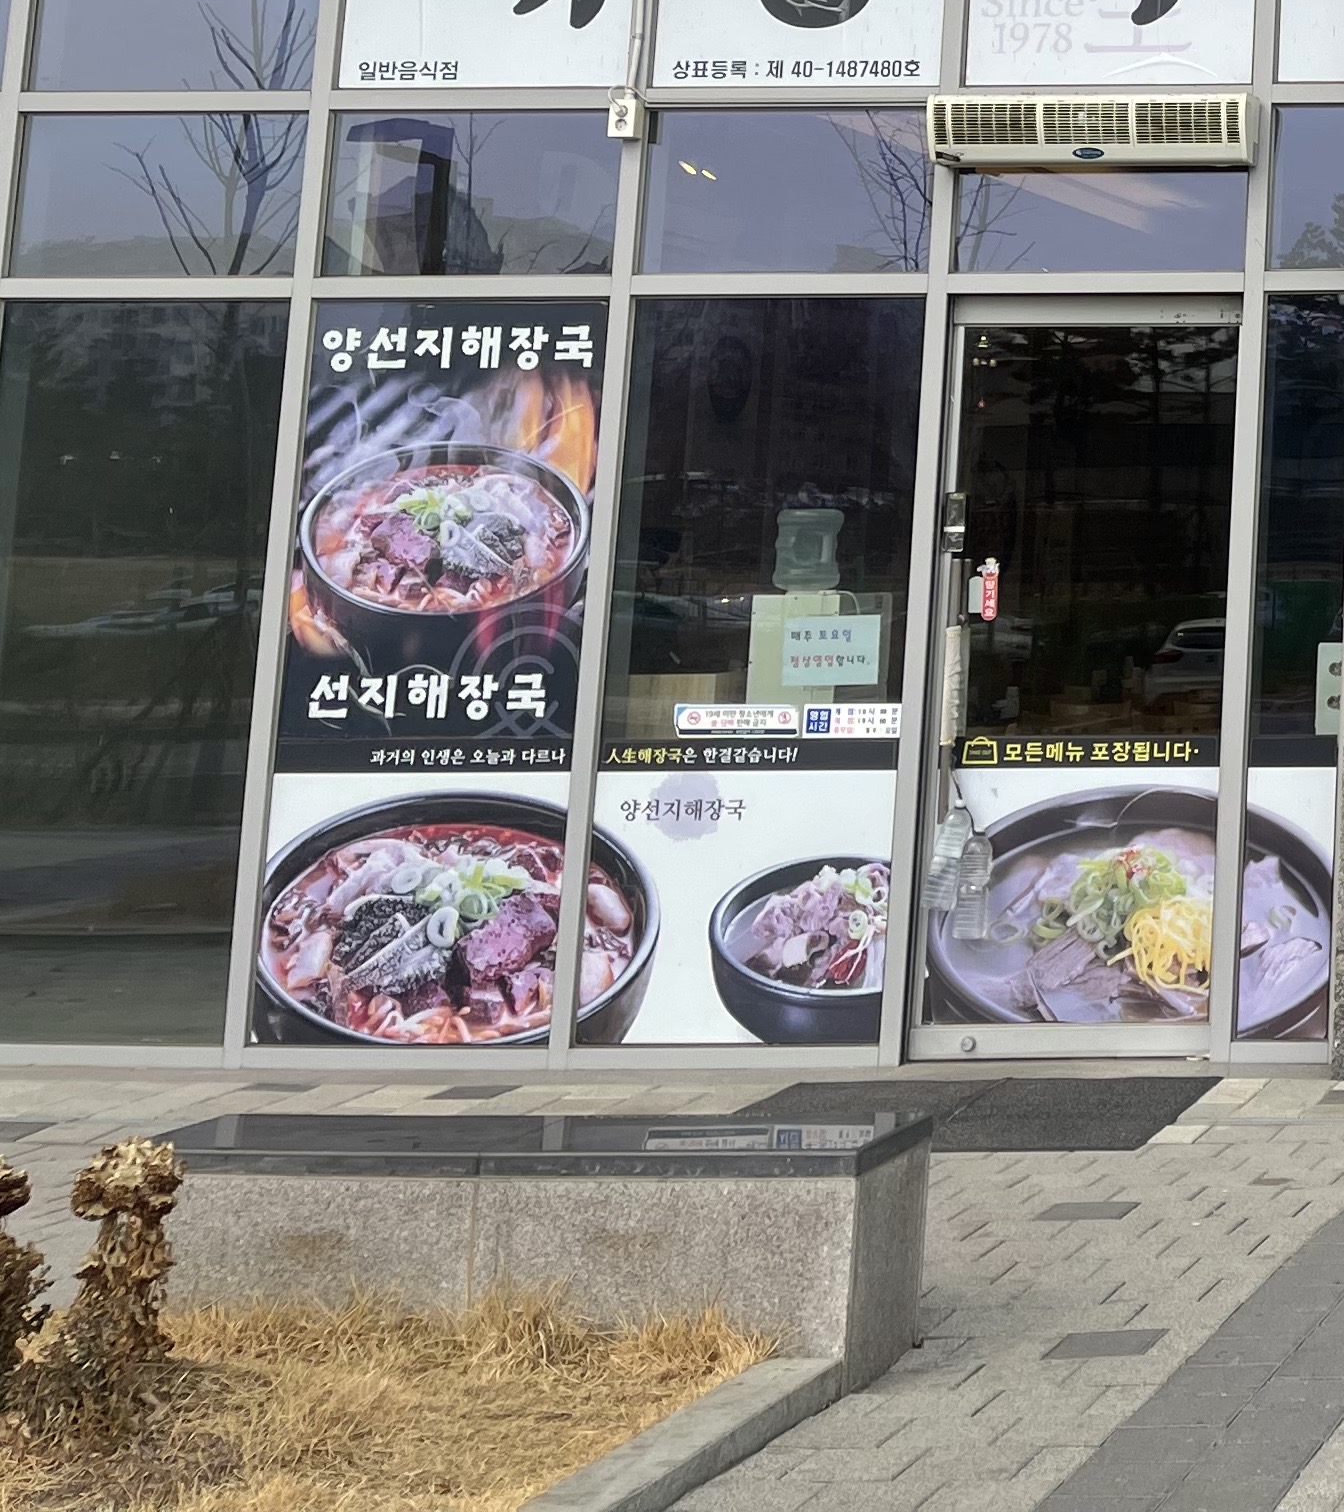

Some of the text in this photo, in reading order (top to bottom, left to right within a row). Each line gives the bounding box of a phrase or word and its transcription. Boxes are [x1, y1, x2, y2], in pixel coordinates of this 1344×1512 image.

[992, 22, 1073, 54] 1978
[358, 60, 459, 81] 일반음식점
[672, 60, 747, 79] 상표등록
[766, 60, 784, 78] 제
[791, 59, 921, 78] 40-1487480호
[321, 324, 594, 374] 양선지해장국
[307, 672, 548, 720] 선지해장국
[808, 721, 828, 732] 시간
[370, 748, 566, 766] 과거의 인생은 오늘과 다르나
[605, 747, 798, 764] 人生해장국은 한결같습니다!
[1003, 741, 1084, 762] 모든메뉴
[620, 799, 746, 822] 양선지해장국
